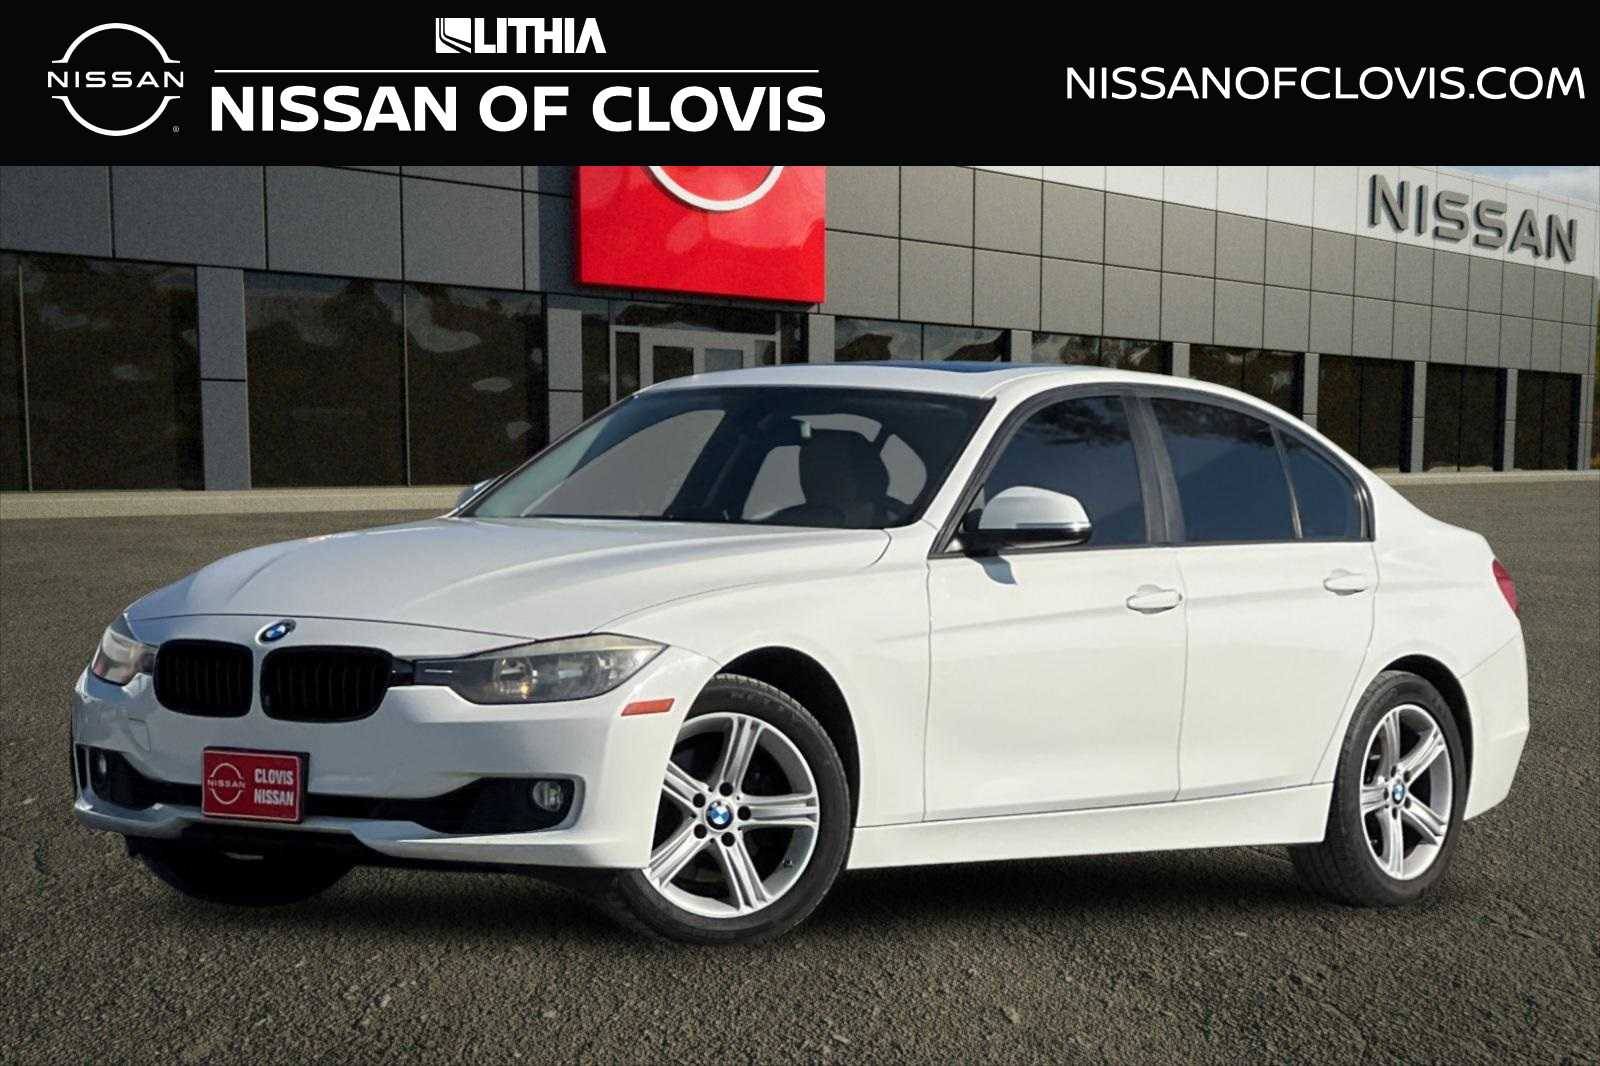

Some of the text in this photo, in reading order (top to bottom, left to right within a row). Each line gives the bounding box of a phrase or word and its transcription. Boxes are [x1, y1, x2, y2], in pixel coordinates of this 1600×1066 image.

[1368, 174, 1578, 263] NISSAN
[207, 778, 246, 788] NISSAN
[254, 768, 294, 785] CLOVIS
[253, 788, 295, 806] NISSAN
